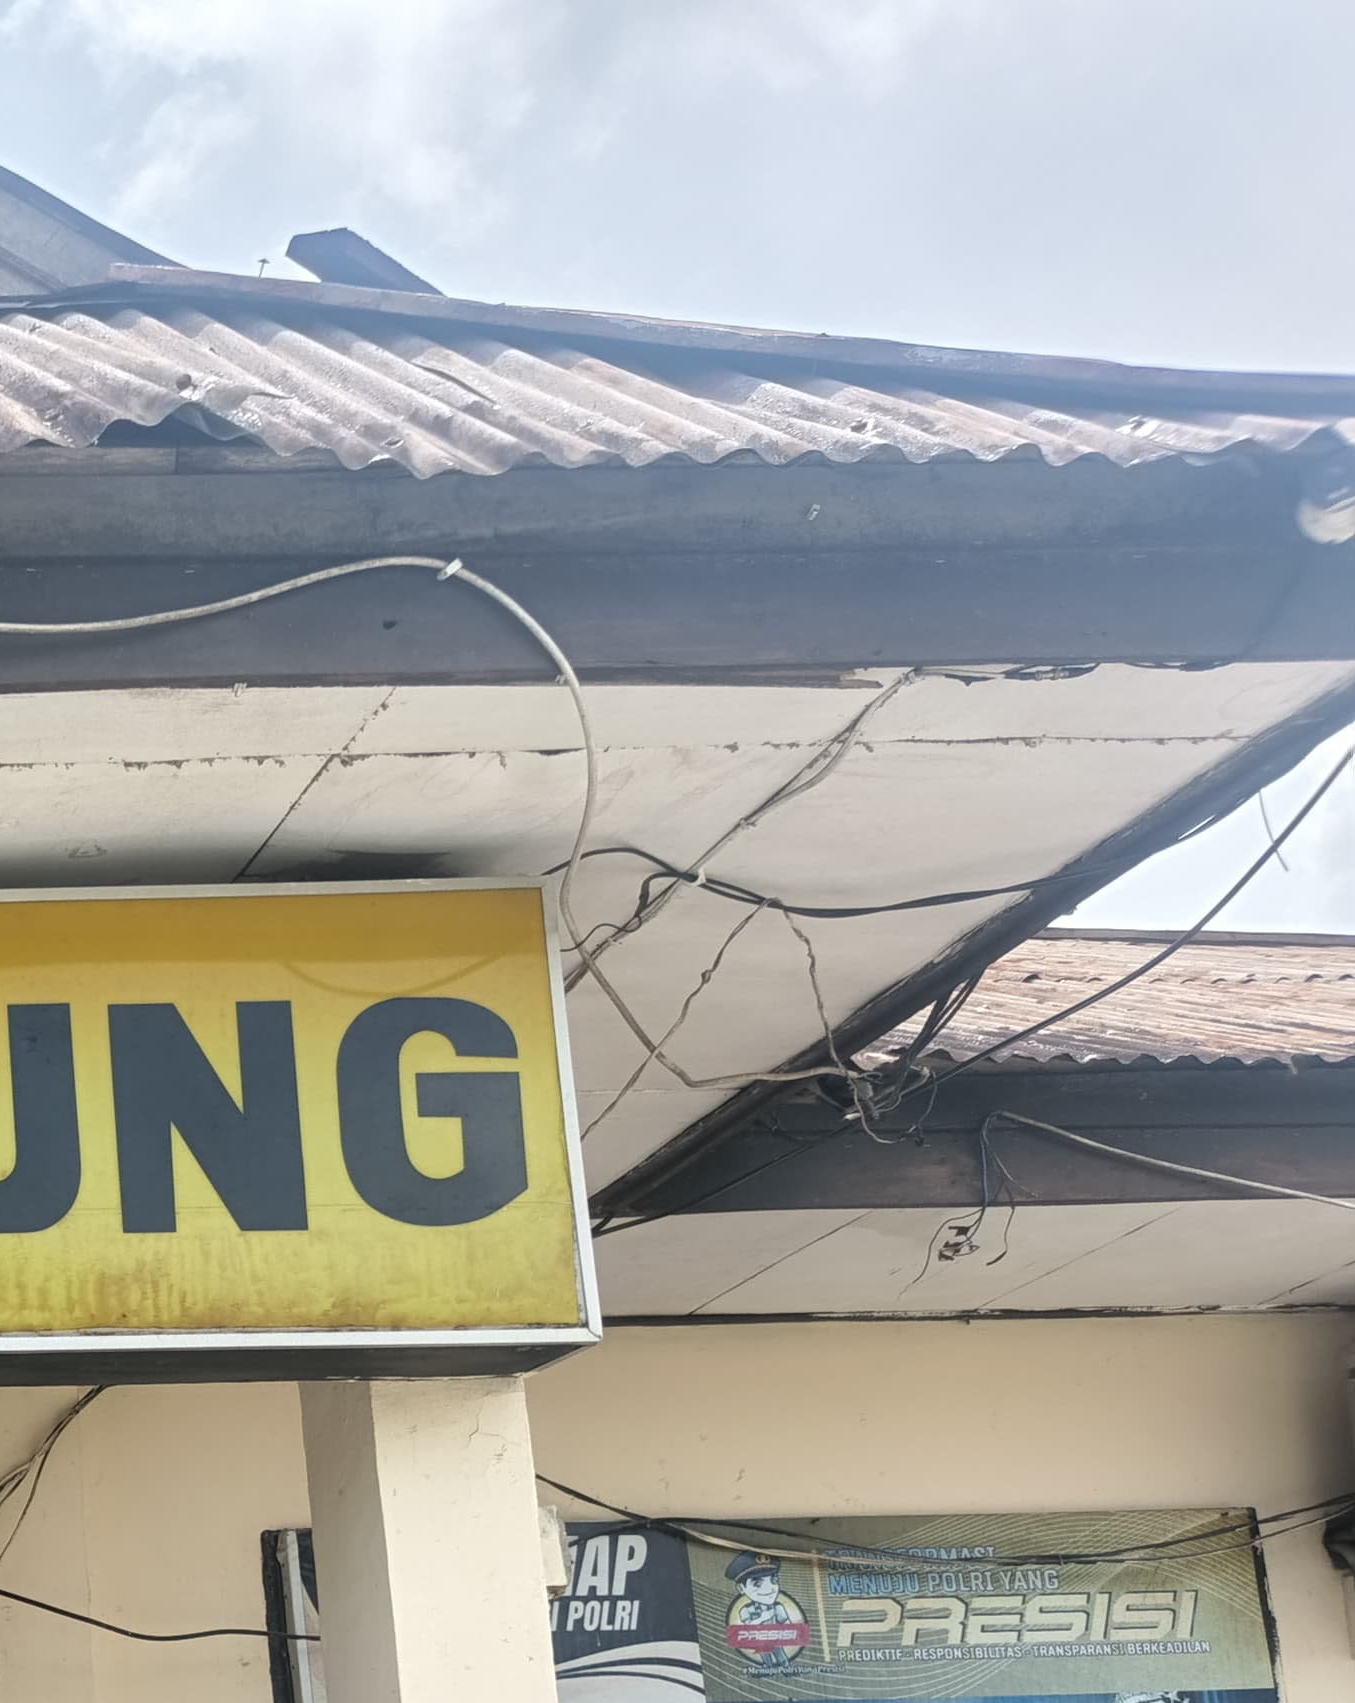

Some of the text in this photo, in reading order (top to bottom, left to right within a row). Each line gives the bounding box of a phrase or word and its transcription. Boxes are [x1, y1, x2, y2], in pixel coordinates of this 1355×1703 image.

[829, 1569, 1059, 1595] MENUJU POLRI YANG
[566, 1600, 640, 1631] POLRI
[837, 1590, 1198, 1648] PRESISI
[737, 1629, 798, 1641] PRESISI
[839, 1641, 1211, 1662] PREDIKTIF RESPONSIBILITAS TRANSPARANSI BERKEADILAN
